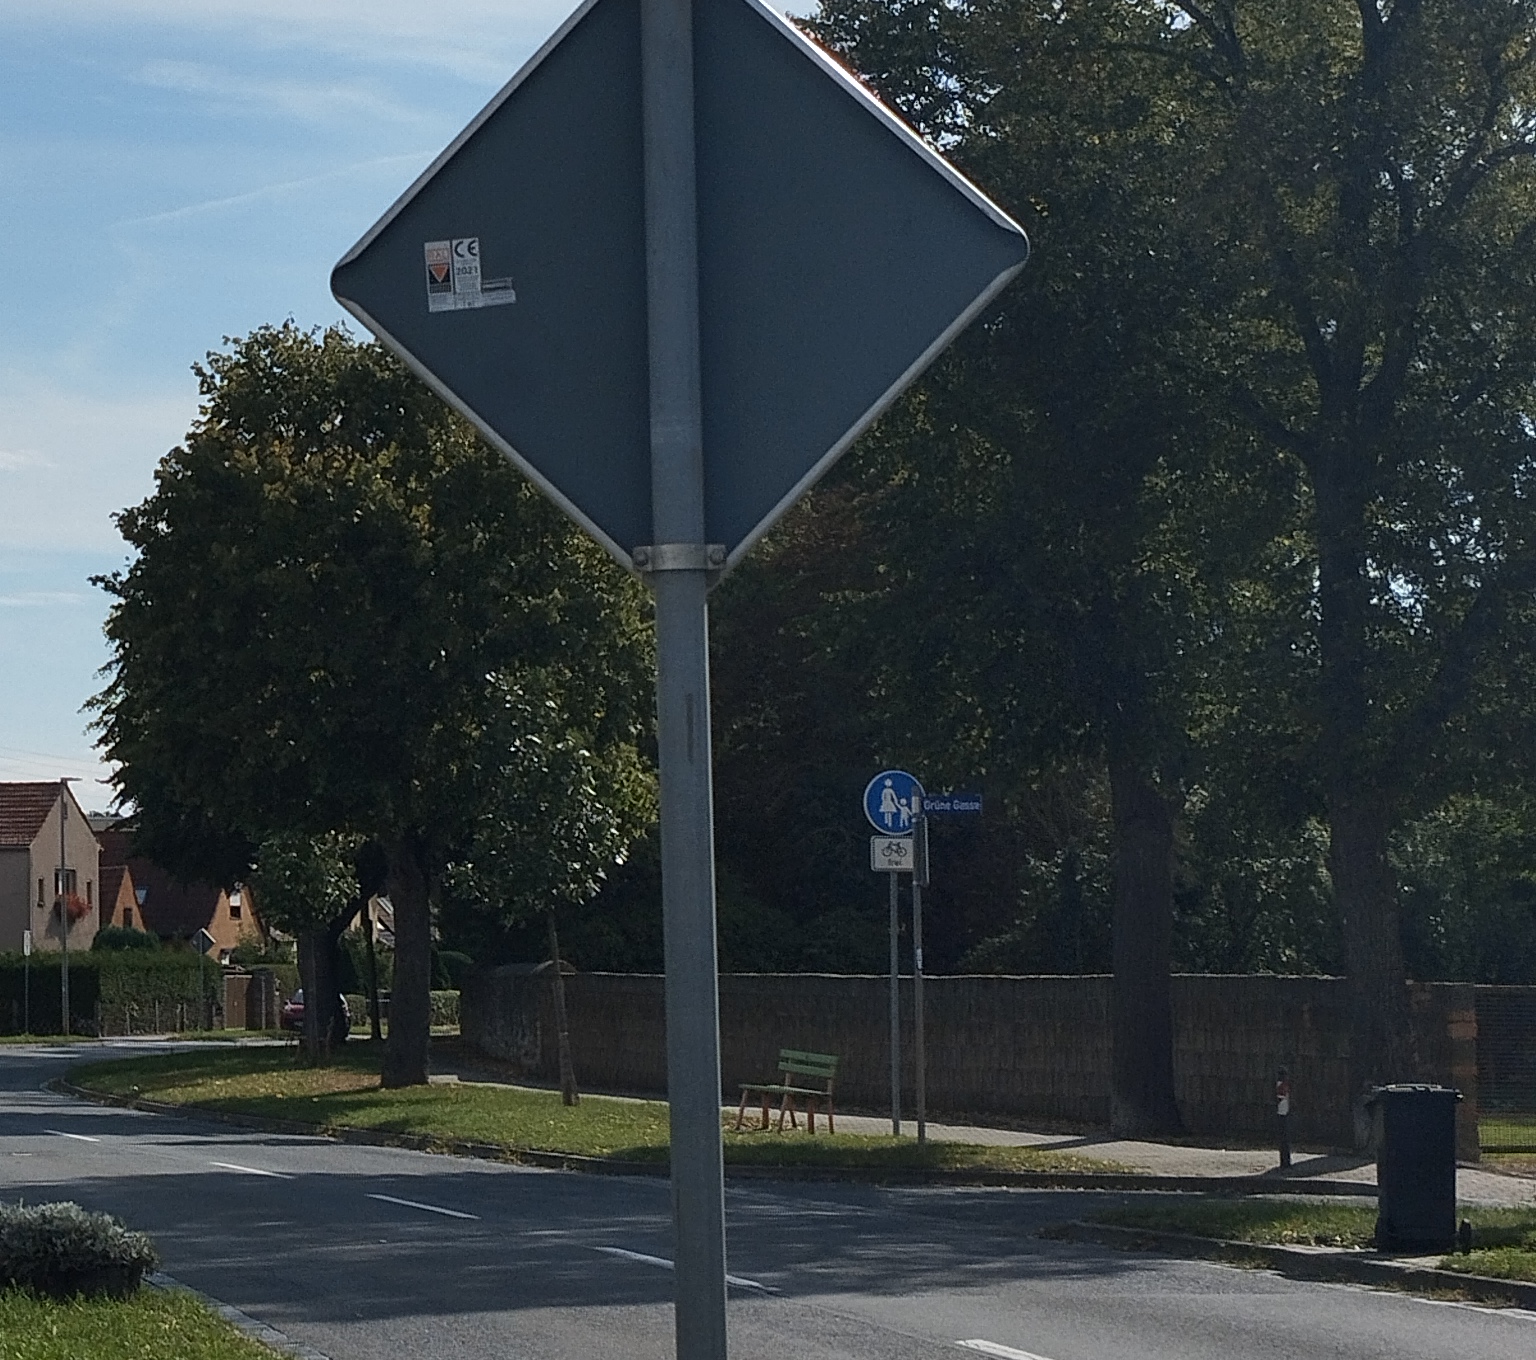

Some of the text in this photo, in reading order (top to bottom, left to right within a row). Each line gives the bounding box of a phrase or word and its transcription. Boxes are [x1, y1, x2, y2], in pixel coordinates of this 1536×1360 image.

[455, 240, 478, 258] CE
[923, 799, 980, 810] Grüne Gasse
